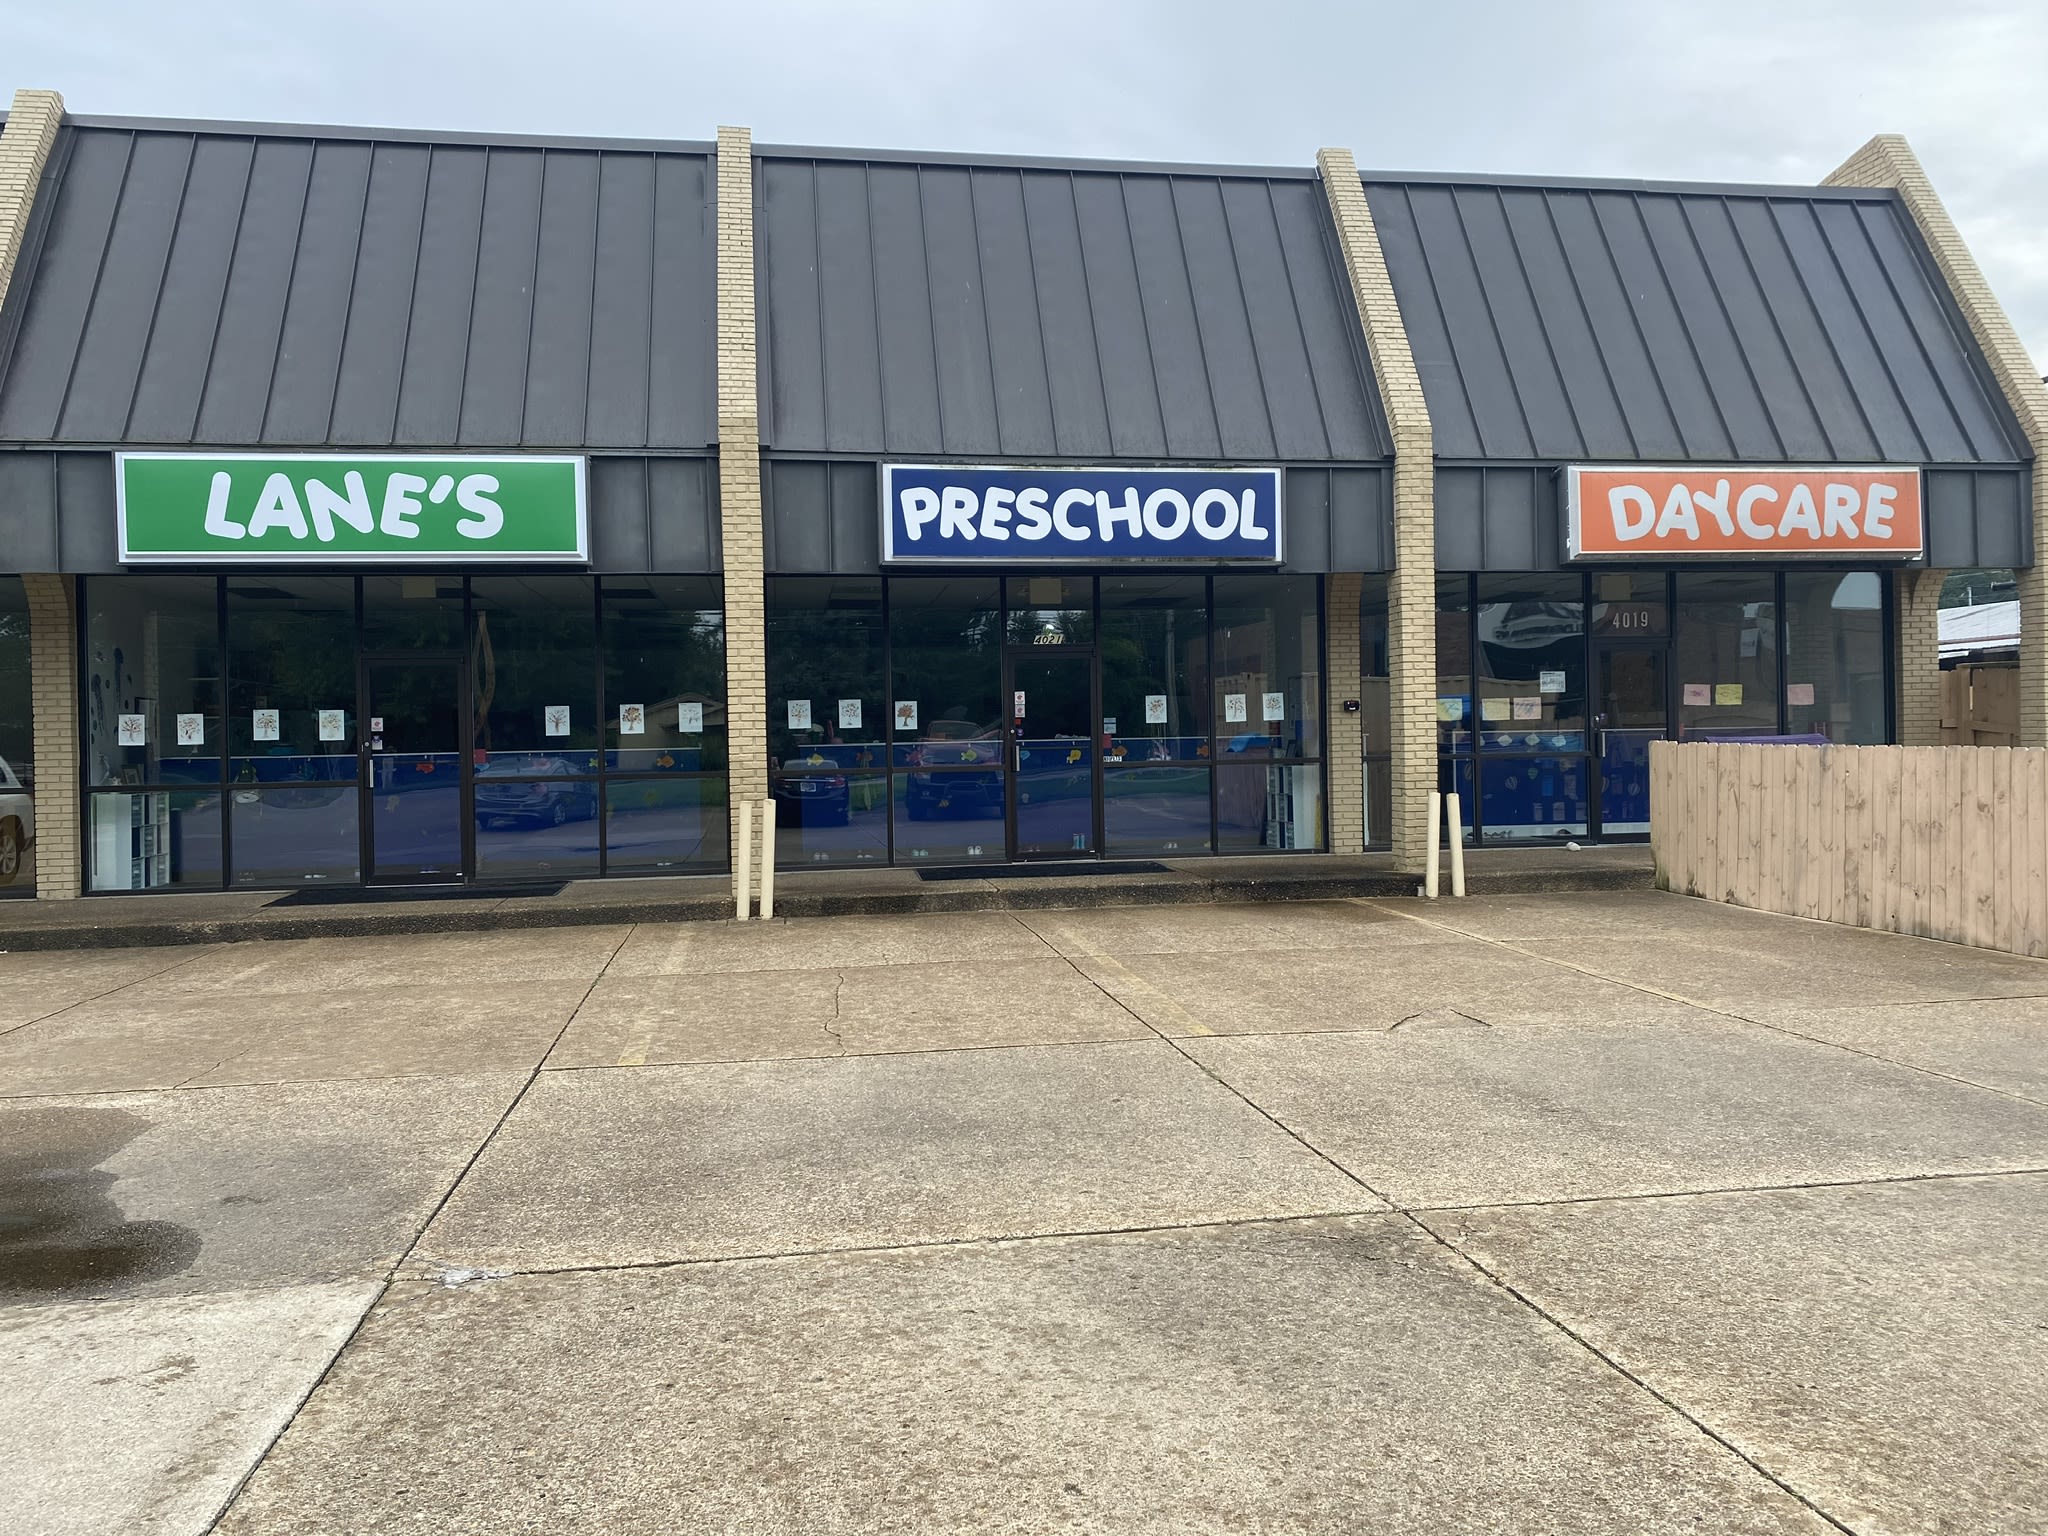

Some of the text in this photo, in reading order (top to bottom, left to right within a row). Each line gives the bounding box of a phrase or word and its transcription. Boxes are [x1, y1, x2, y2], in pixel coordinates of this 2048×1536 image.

[205, 471, 503, 539] LANE'S
[901, 487, 1269, 541] PRESCHOOL
[1608, 479, 1899, 541] DAYCARE
[1035, 634, 1061, 645] 4021
[1612, 611, 1649, 629] 4019
